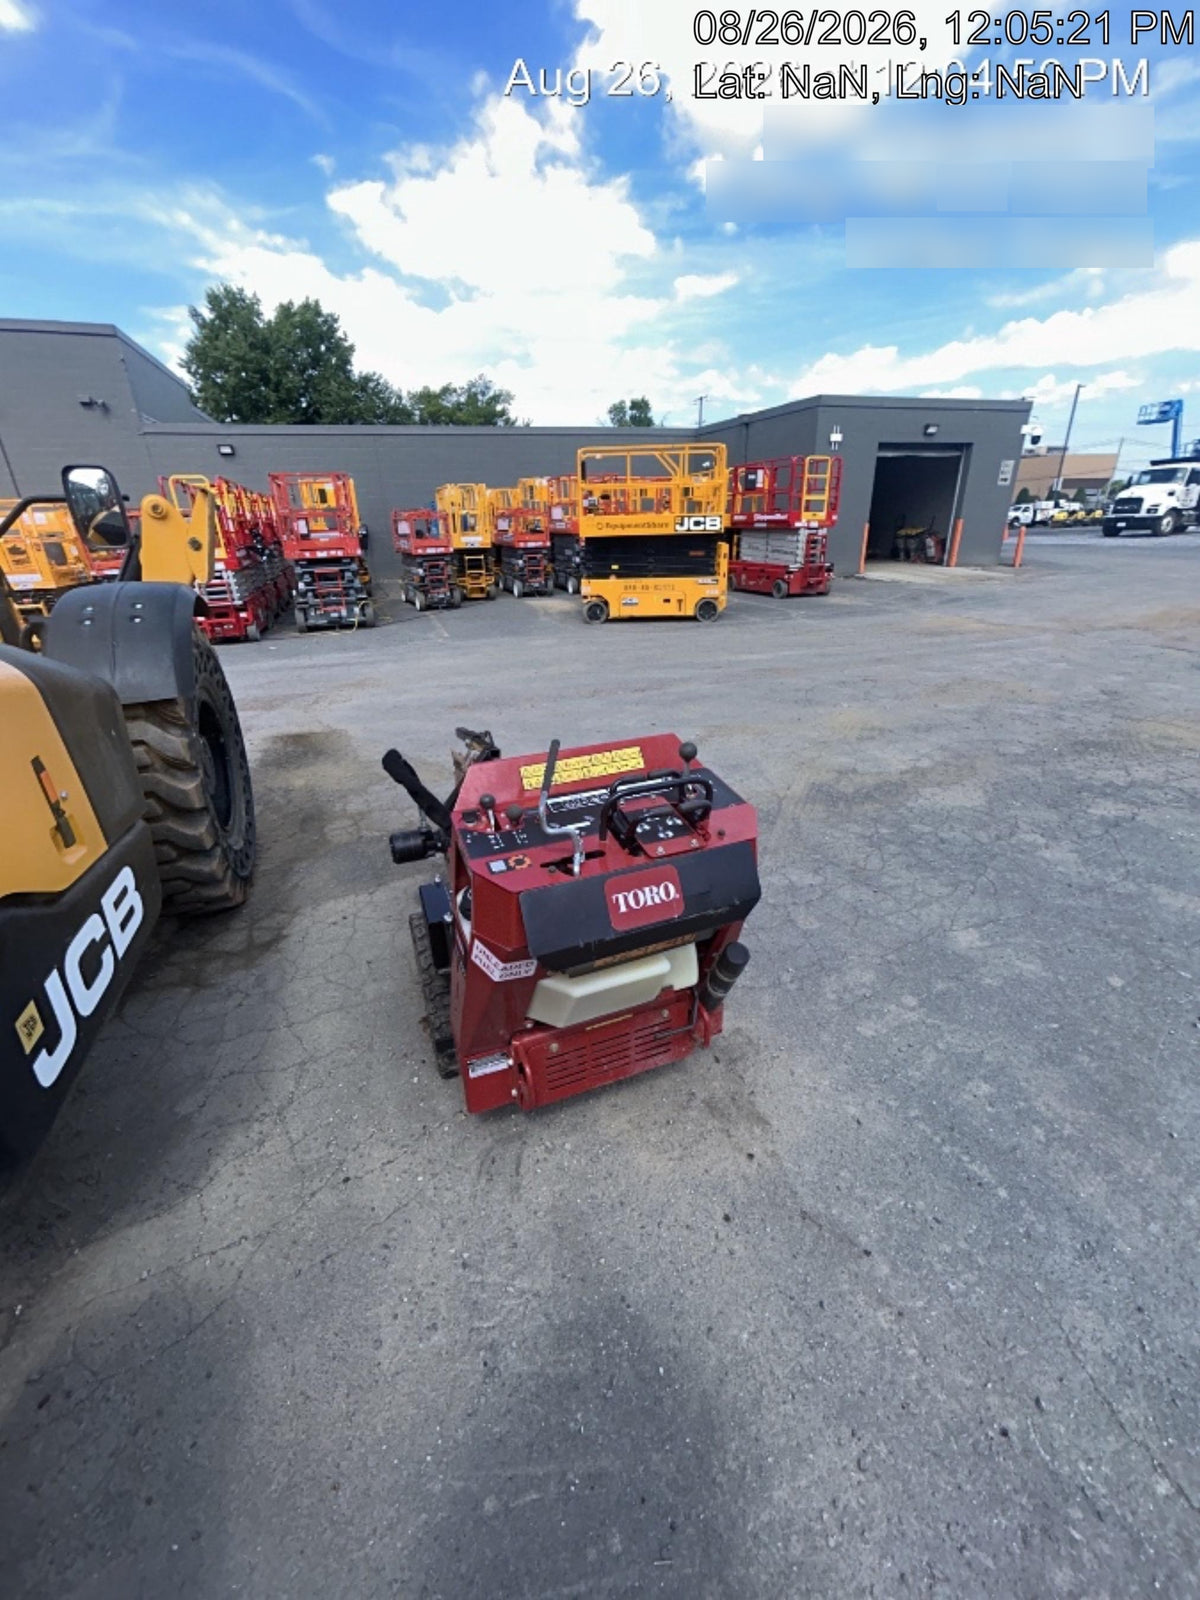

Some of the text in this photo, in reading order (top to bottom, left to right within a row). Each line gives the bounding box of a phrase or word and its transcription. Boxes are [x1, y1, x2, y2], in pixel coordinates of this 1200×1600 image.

[674, 515, 722, 531] JCB
[611, 881, 676, 914] TORO
[32, 865, 144, 1088] JCB
